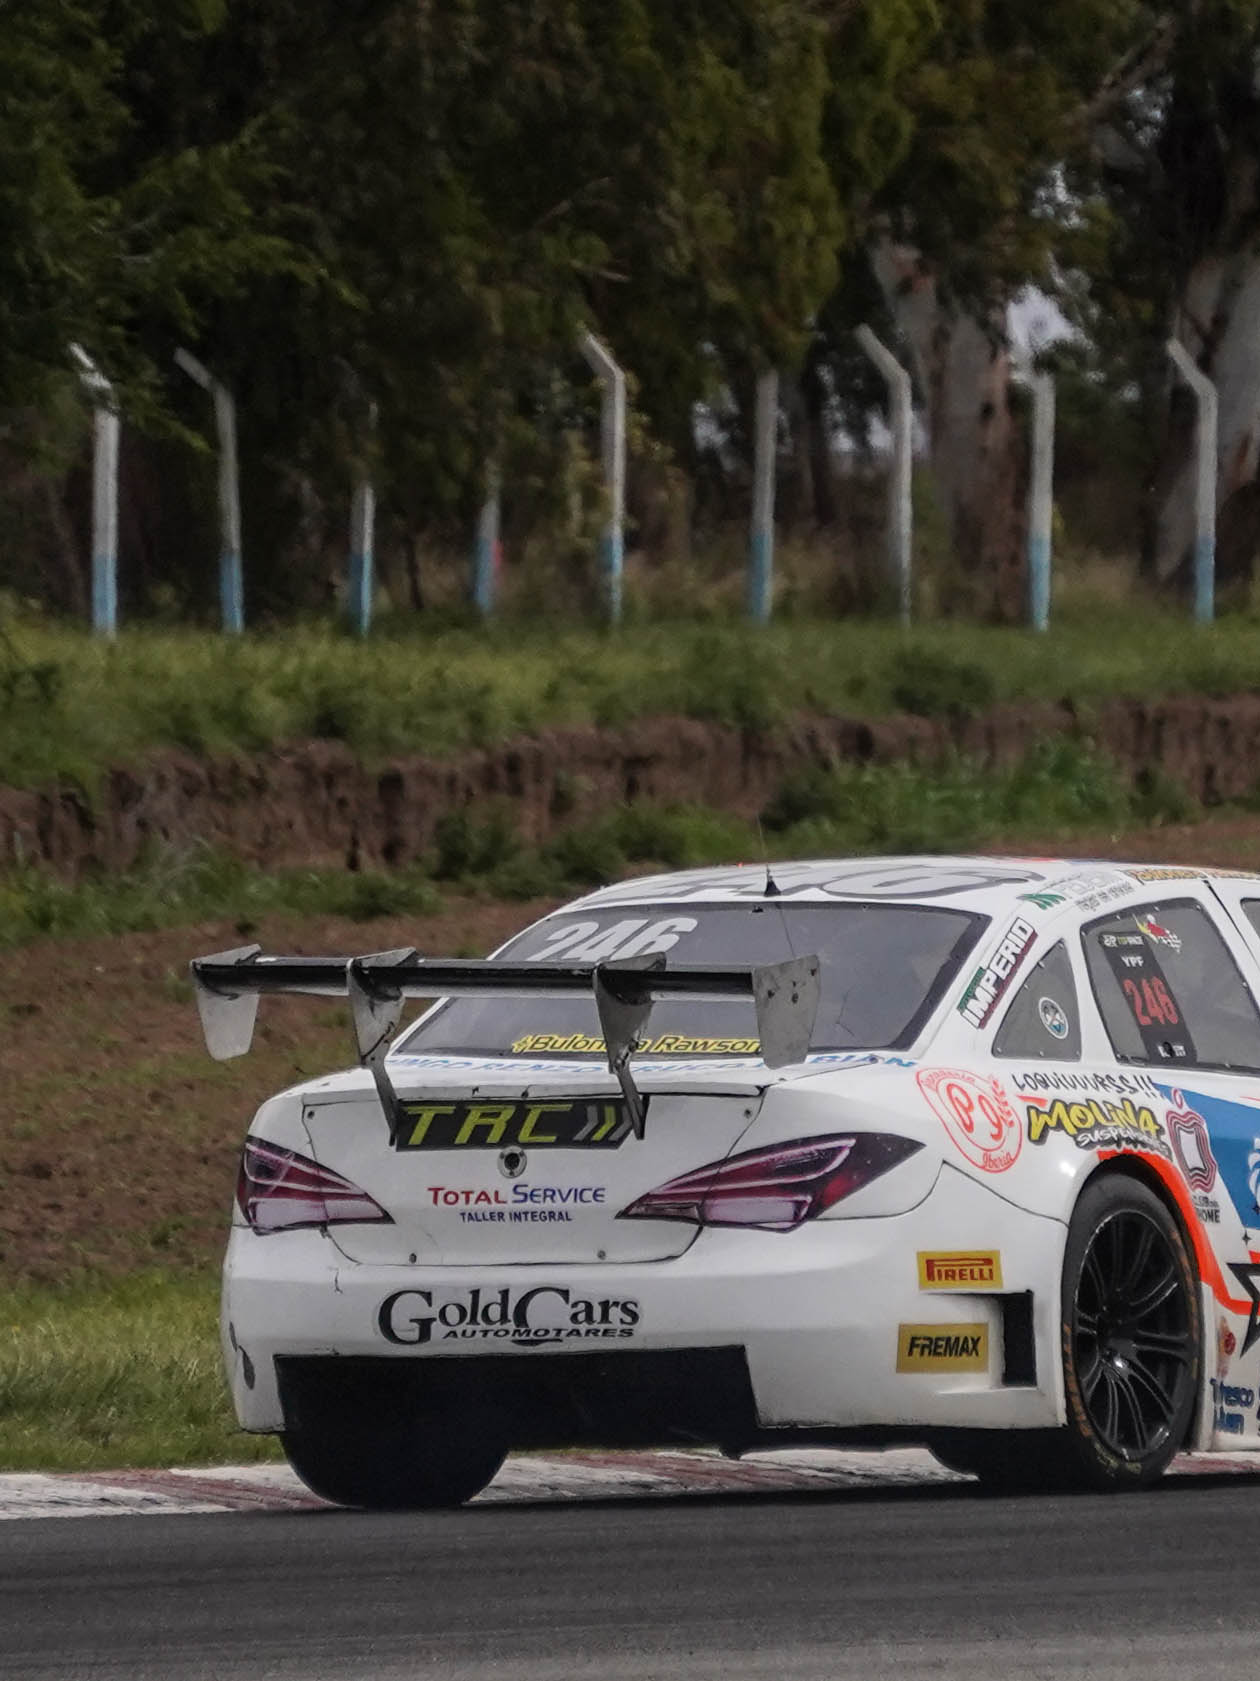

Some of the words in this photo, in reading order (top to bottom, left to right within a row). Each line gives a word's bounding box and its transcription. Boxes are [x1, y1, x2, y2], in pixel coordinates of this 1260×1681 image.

[524, 917, 698, 961] 246
[1121, 956, 1144, 967] YPF
[1123, 976, 1179, 1026] 246
[407, 1104, 573, 1146] TRC
[427, 1187, 508, 1206] TOTAL
[511, 1184, 606, 1205] SERVICE
[460, 1211, 505, 1224] TALLER
[508, 1210, 573, 1223] INTEGRAL
[926, 1257, 994, 1281] PIRELLI
[907, 1335, 981, 1357] FREMAX
